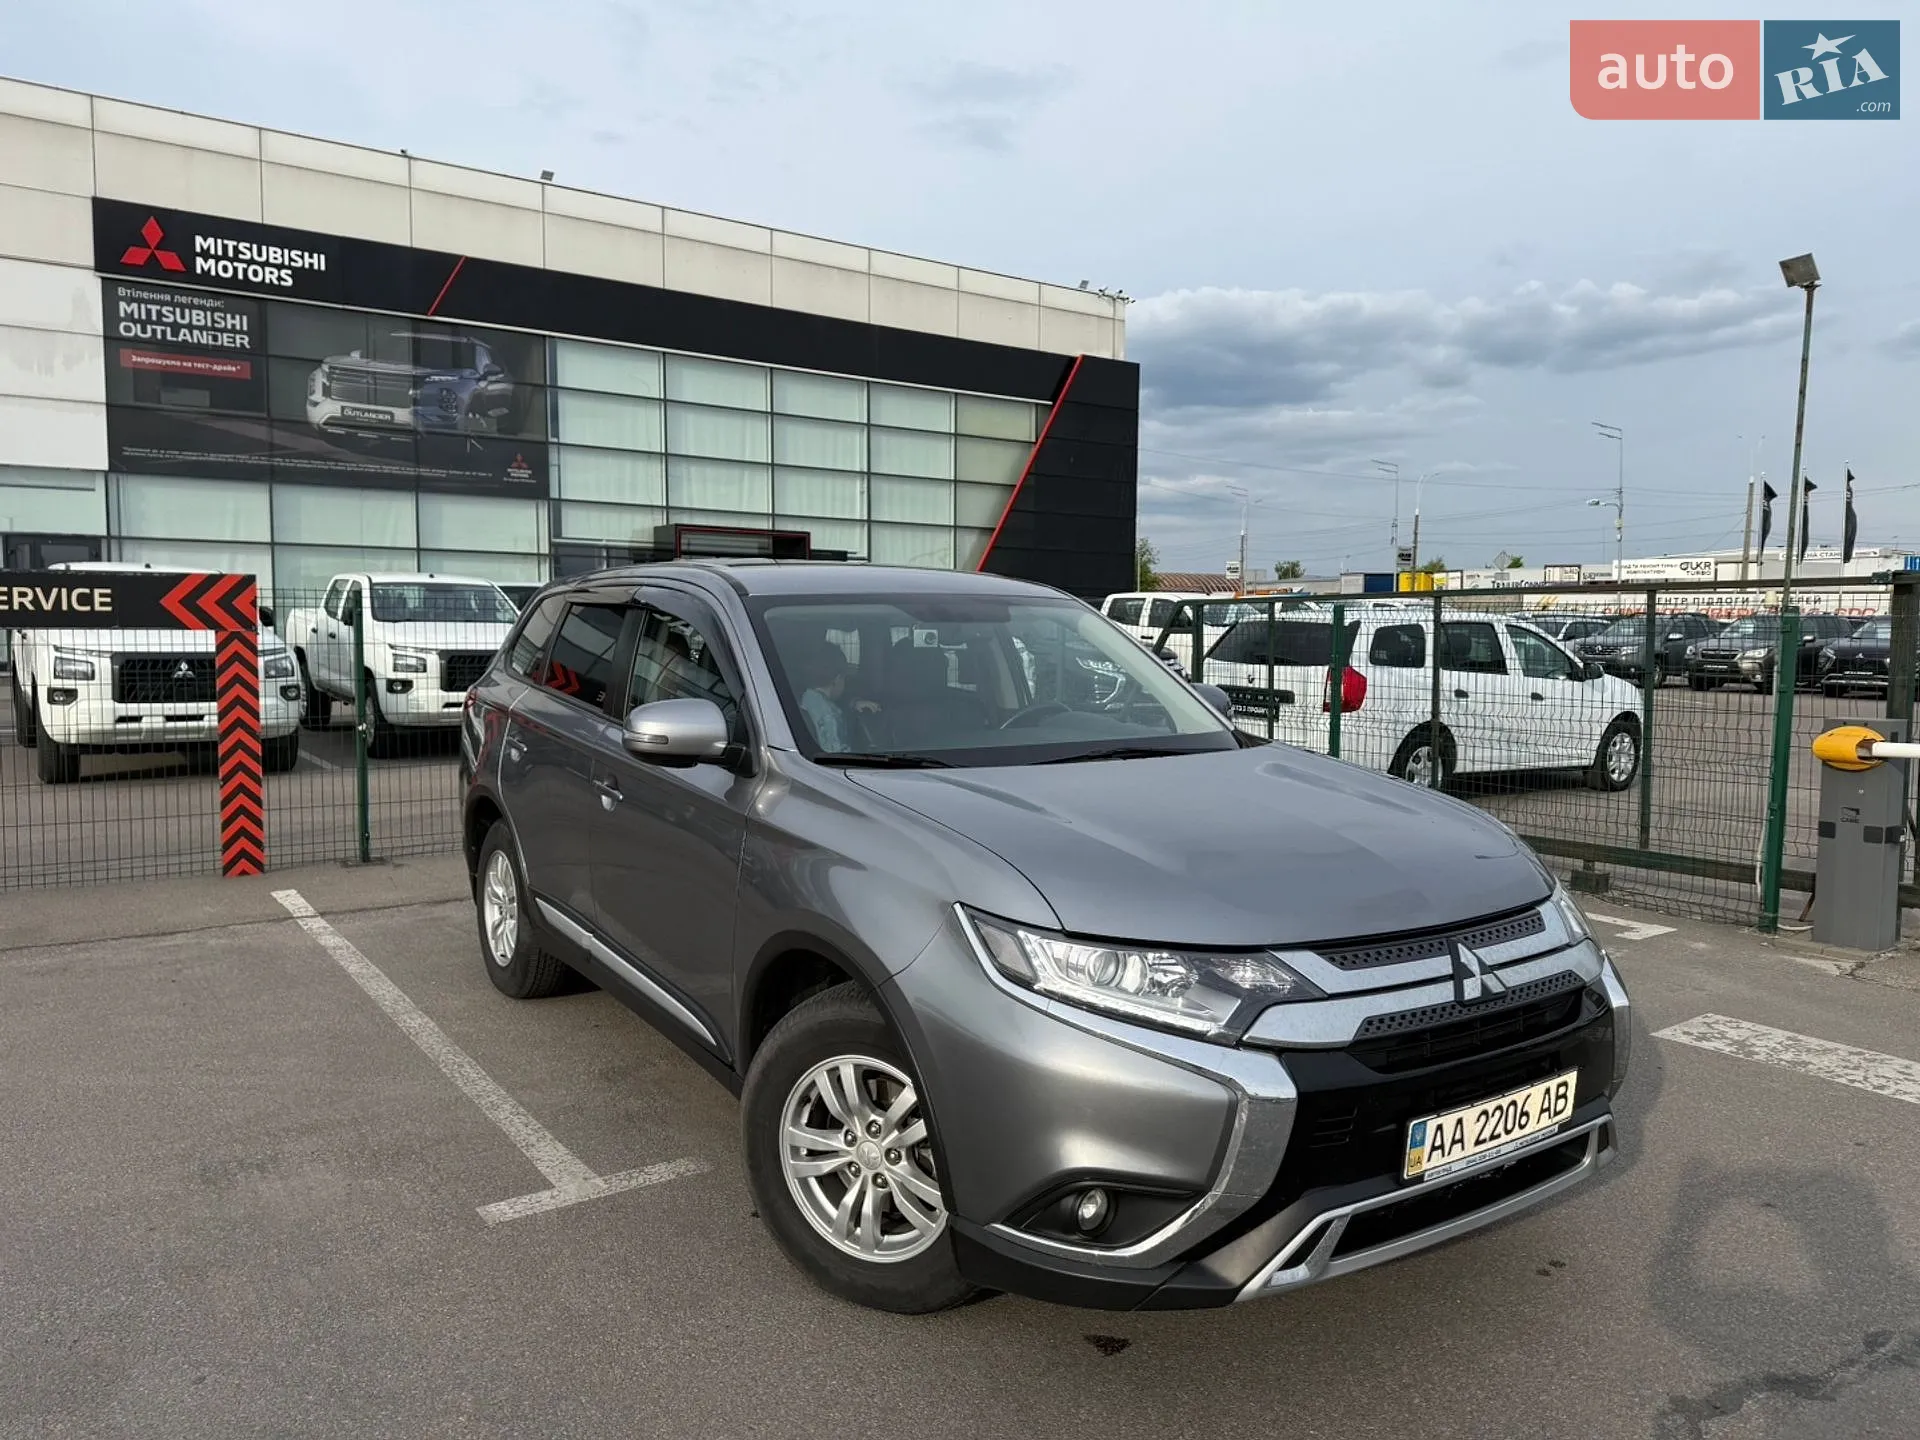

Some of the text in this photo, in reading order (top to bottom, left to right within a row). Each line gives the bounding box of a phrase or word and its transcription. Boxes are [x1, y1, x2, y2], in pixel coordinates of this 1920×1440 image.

[194, 234, 326, 271] MITSUBISHI
[195, 256, 294, 287] MOTORS
[117, 286, 225, 308] Втілення легенди:
[119, 301, 248, 331] MITSUBISHI
[118, 321, 251, 349] OUTLANDER
[1657, 597, 1688, 606] ЕНТР
[1427, 1116, 1465, 1162] AA
[1474, 1092, 1531, 1147] 2206
[1536, 1080, 1569, 1124] AB
